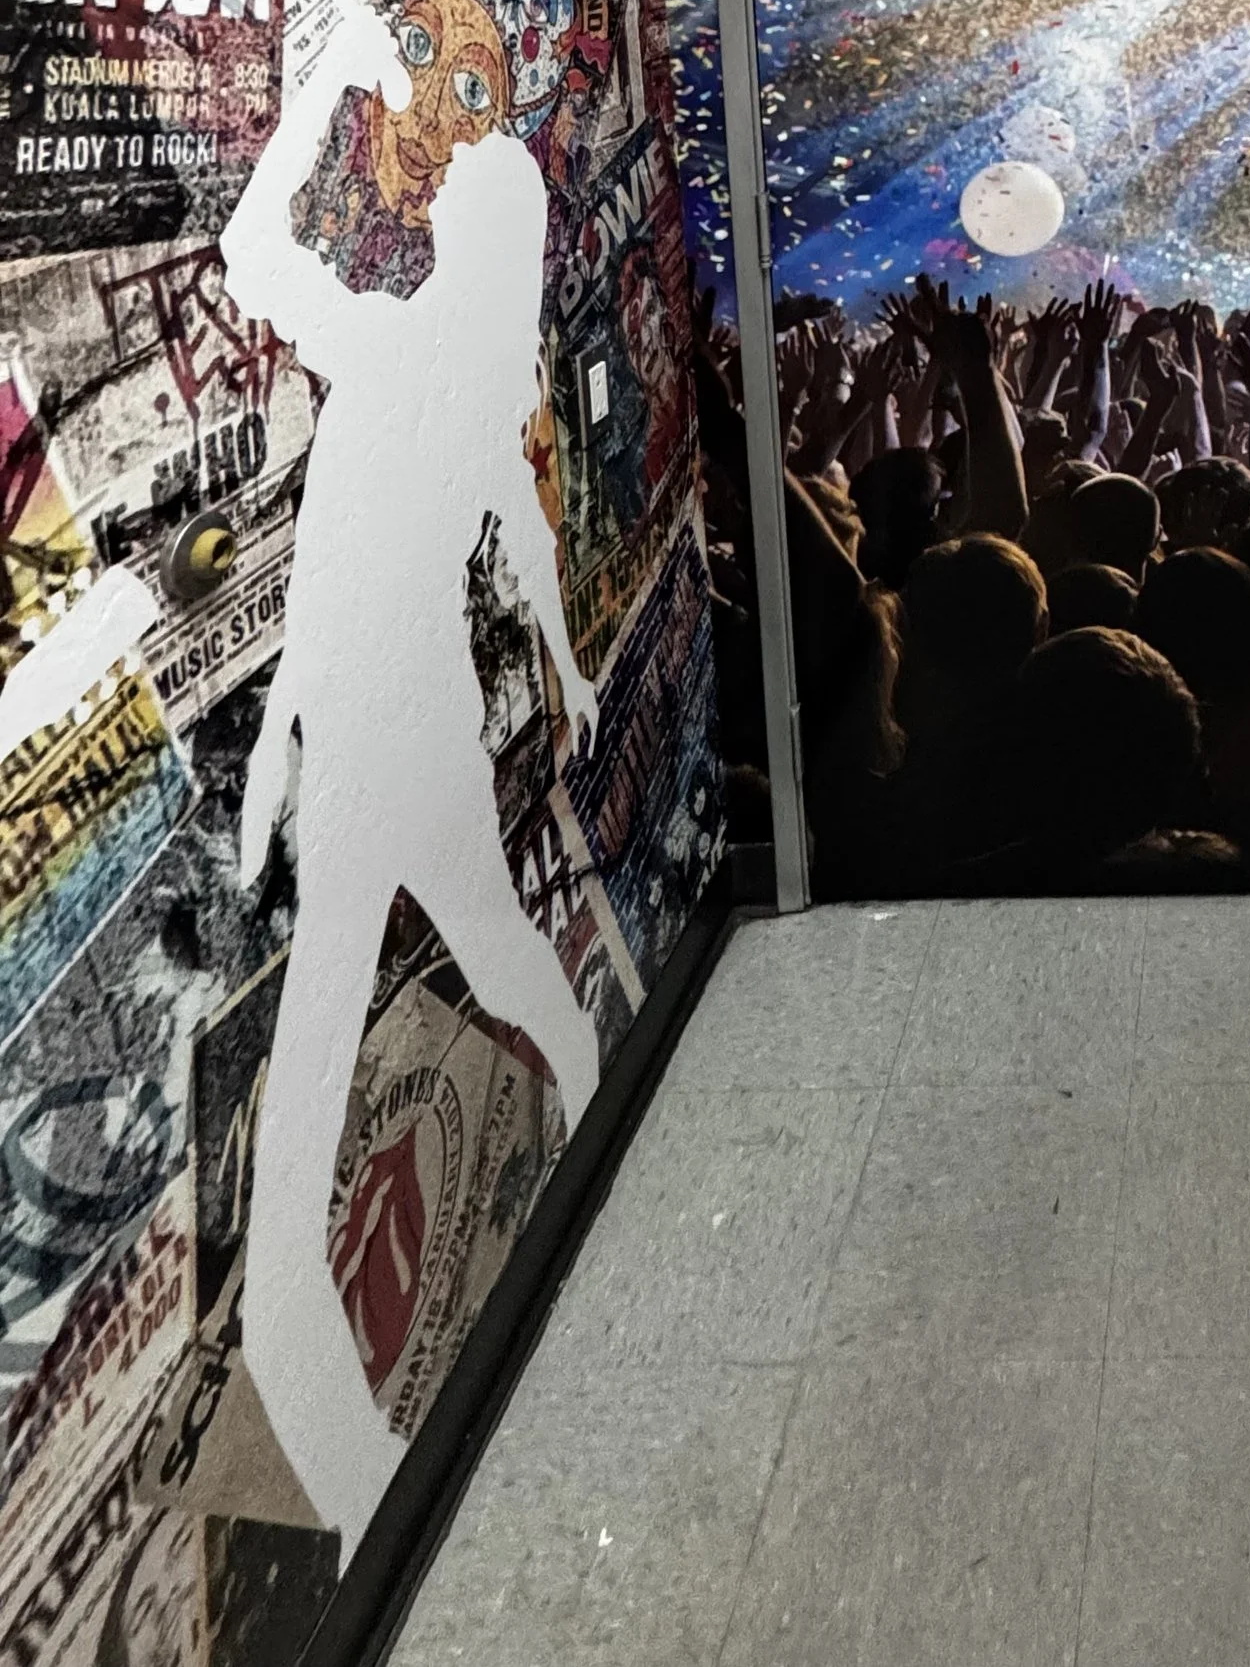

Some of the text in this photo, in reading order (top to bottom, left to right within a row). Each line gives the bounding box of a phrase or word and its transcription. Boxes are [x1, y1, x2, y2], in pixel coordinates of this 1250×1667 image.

[44, 54, 131, 87] STADIUM
[43, 91, 119, 124] KUALA
[16, 136, 105, 175] READY
[115, 134, 145, 168] TO
[558, 137, 670, 319] BOWIE
[152, 631, 225, 703] MUSIC
